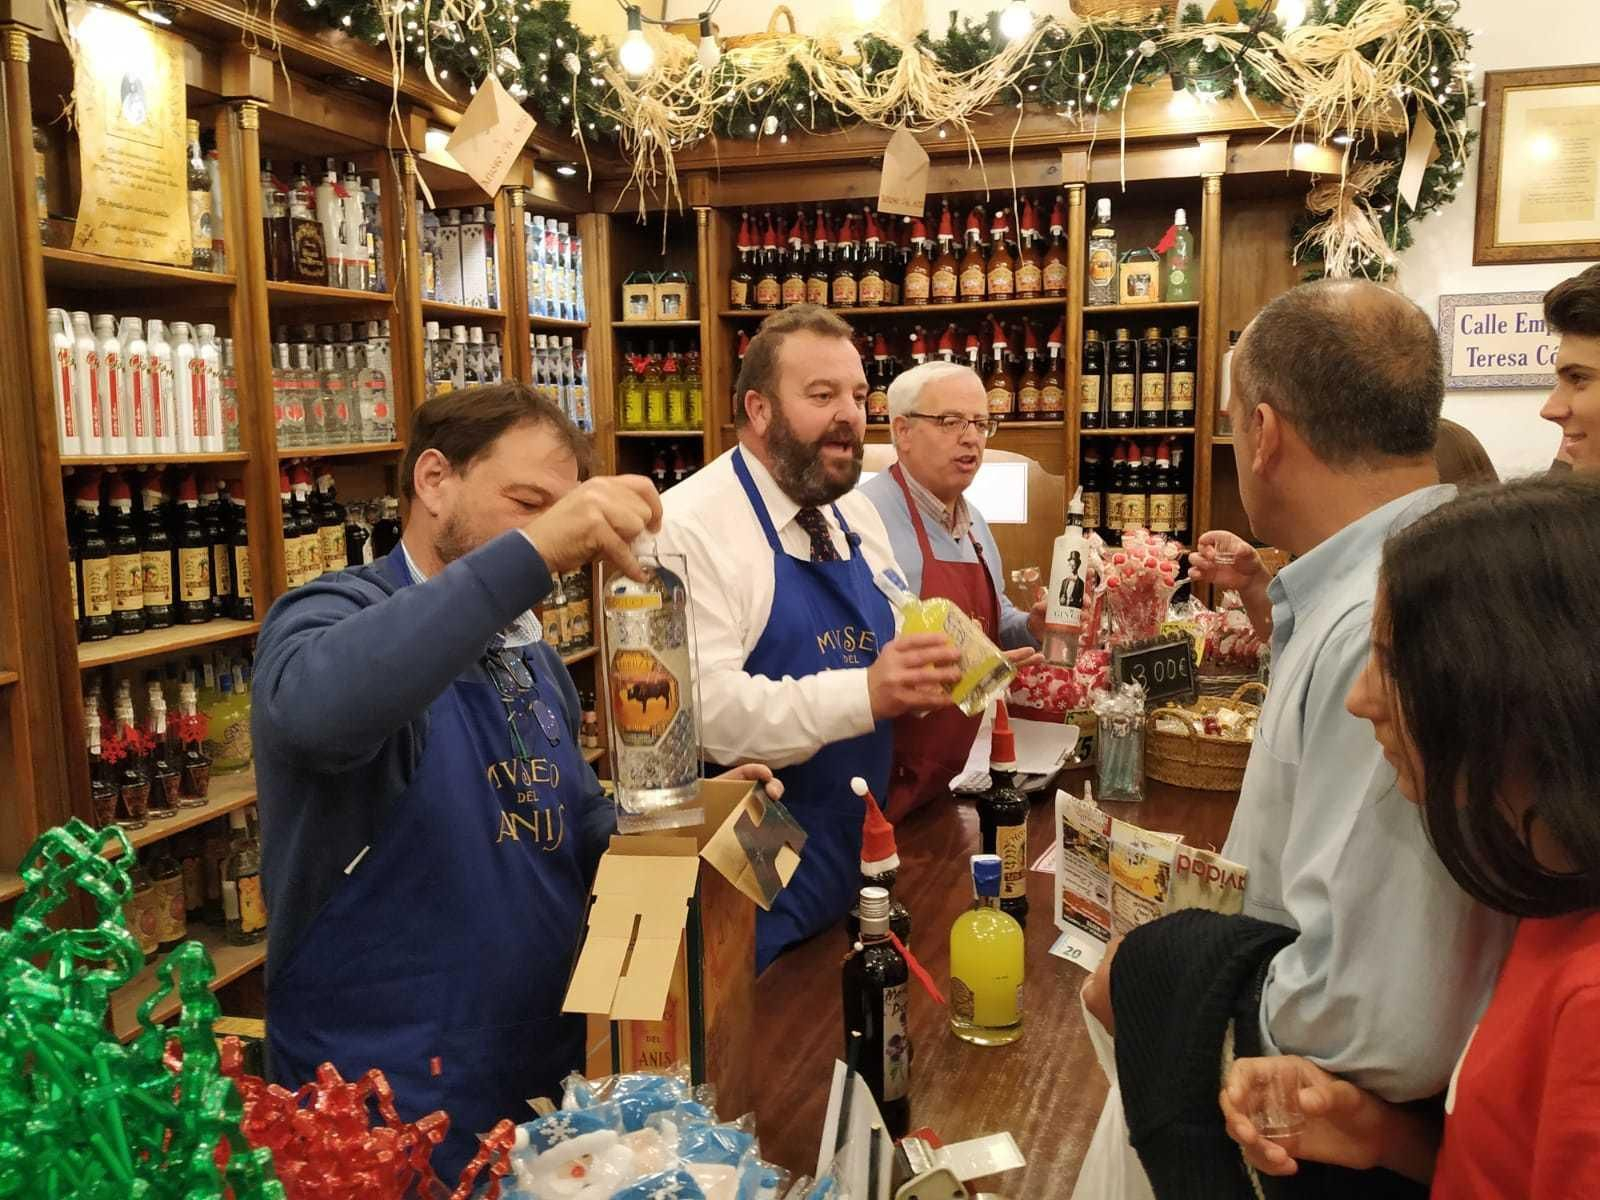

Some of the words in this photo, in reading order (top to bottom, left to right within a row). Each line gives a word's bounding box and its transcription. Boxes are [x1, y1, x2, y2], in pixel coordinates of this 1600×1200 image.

[1460, 313, 1508, 336] Calle
[1466, 346, 1528, 368] Teresa
[842, 654, 860, 665] DEL
[516, 789, 540, 803] DEL
[496, 803, 566, 852] ANIS
[1063, 945, 1083, 959] 20
[639, 1048, 673, 1068] ANIS
